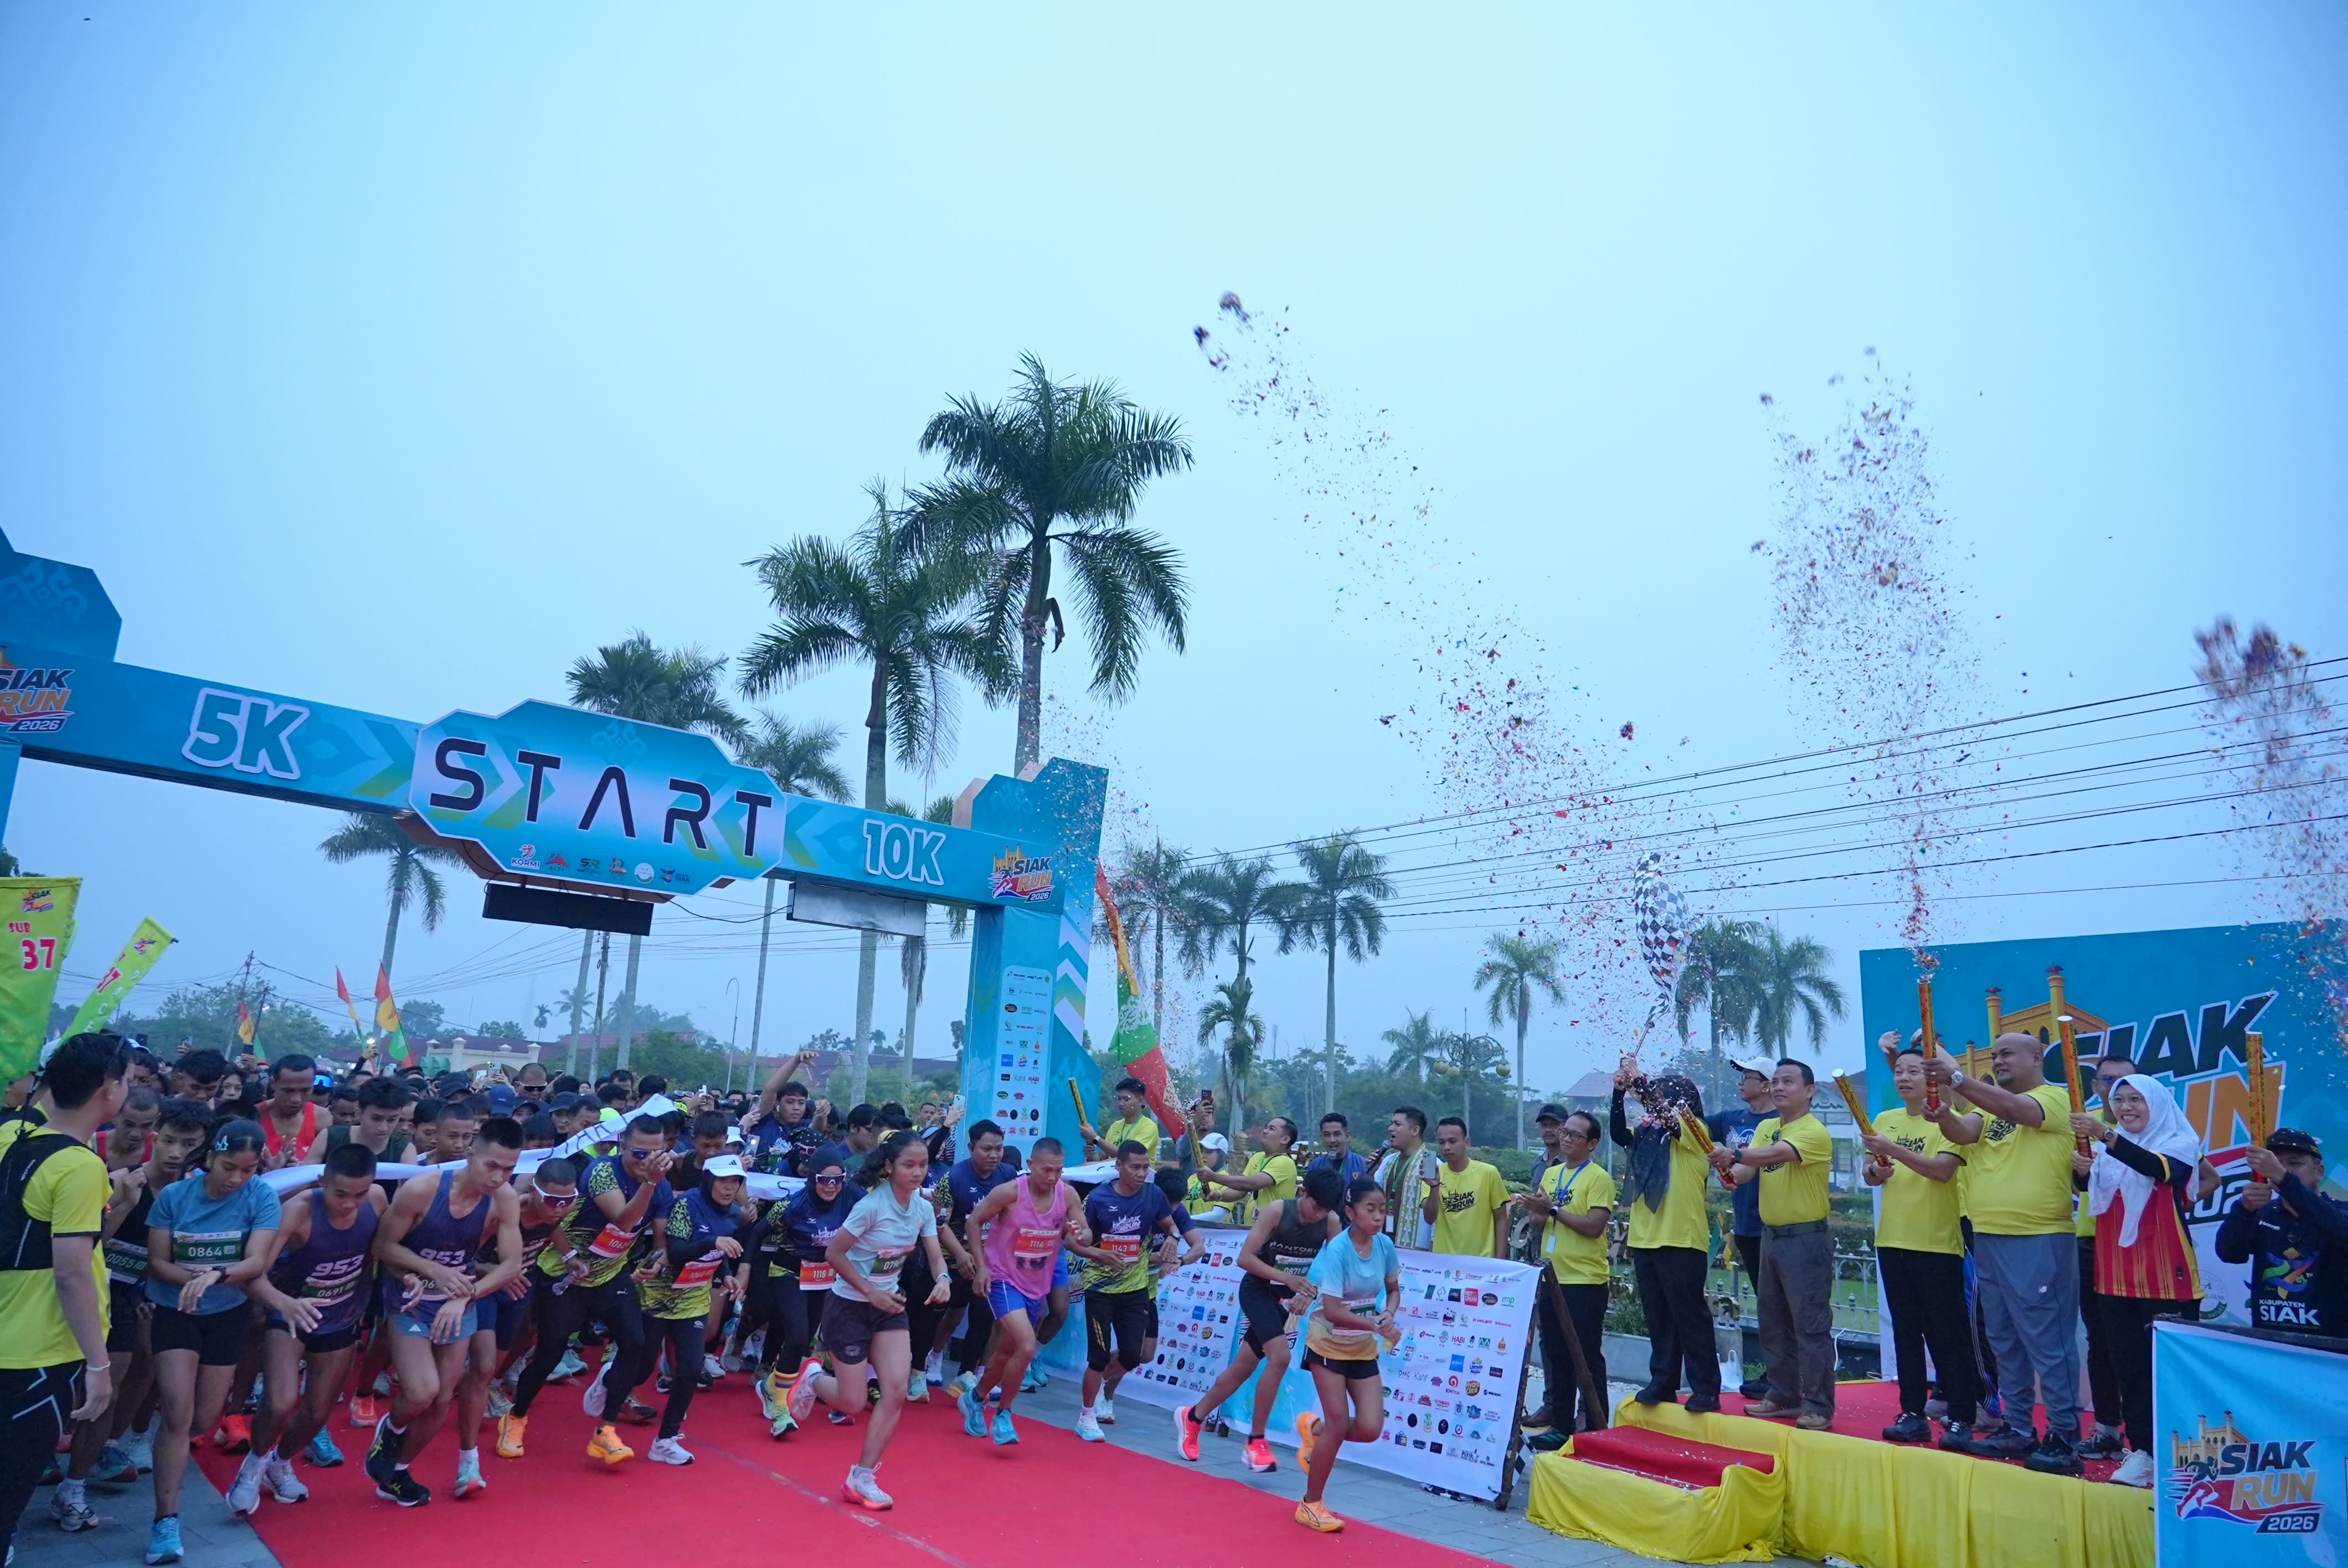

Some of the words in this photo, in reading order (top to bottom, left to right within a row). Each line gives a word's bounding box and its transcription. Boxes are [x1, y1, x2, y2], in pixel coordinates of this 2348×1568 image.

[18, 720, 60, 731] 2026
[182, 688, 310, 780] 5K
[429, 737, 772, 857] START
[863, 818, 946, 886] 10K
[511, 858, 540, 869] KORMI
[1013, 856, 1053, 875] SIAK
[1016, 871, 1053, 892] RUN
[32, 889, 52, 901] SIAK
[1031, 893, 1049, 901] 2026
[8, 922, 31, 933] SUB
[21, 938, 56, 971] 37
[1454, 1191, 1475, 1203] SIAK
[1456, 1197, 1475, 1210] RUN
[188, 1247, 222, 1257] 0864
[419, 1248, 466, 1265] 953
[106, 1253, 135, 1268] 0055
[310, 1254, 364, 1276] 953
[813, 1270, 826, 1278] 1118
[317, 1286, 344, 1297] 0691
[2259, 1299, 2305, 1309] KABUPATEN
[2259, 1305, 2321, 1325] SIAK
[1451, 1335, 1466, 1344] HABI
[1413, 1372, 1428, 1382] Kahf
[2218, 1440, 2316, 1476] SIAK
[2230, 1470, 2317, 1510] RUN
[2267, 1516, 2314, 1530] 2026
